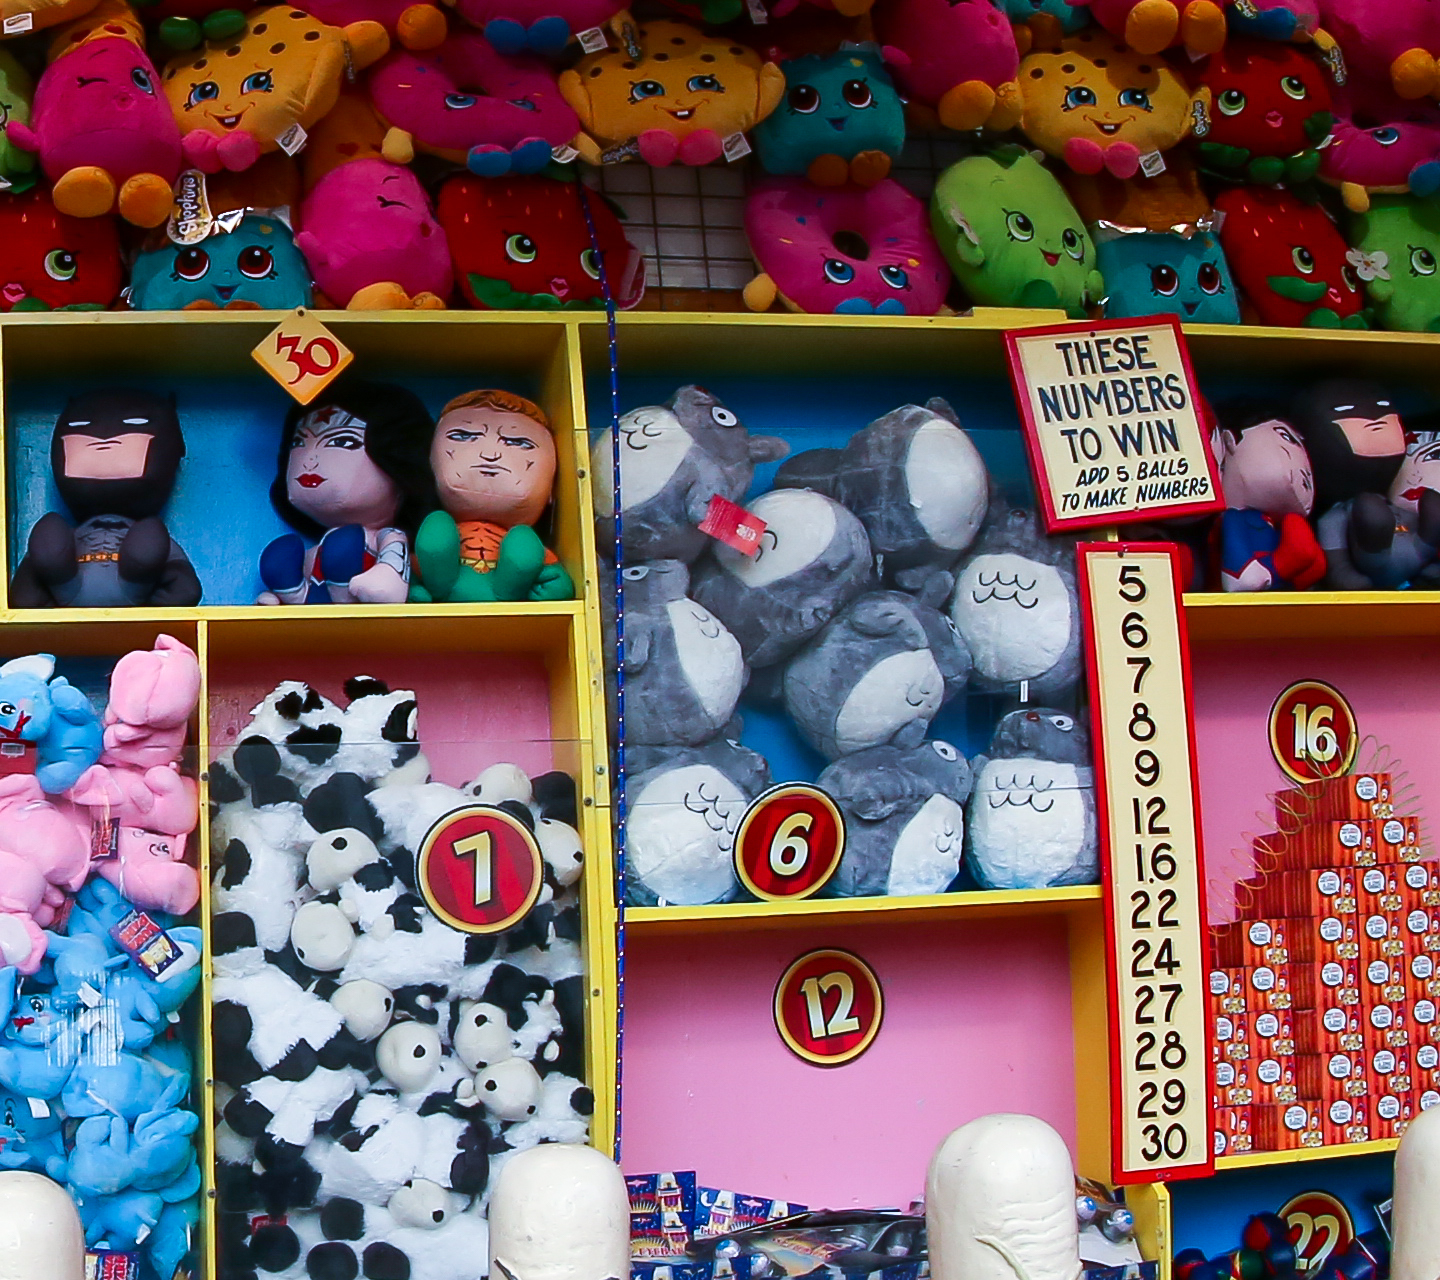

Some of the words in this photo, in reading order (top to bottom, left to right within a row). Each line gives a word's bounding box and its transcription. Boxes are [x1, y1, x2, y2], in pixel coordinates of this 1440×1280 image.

[174, 175, 198, 238] Shopkins
[275, 332, 339, 384] 30
[1055, 335, 1158, 376] THESE
[1037, 374, 1186, 423] NUMBERS
[1060, 426, 1103, 464] TO
[1108, 419, 1181, 458] WIN
[1076, 467, 1110, 487] ADD
[1117, 466, 1130, 483] 5
[1137, 459, 1189, 480] BALLS
[1062, 492, 1081, 510] TO
[1084, 487, 1128, 508] MAKE
[1137, 478, 1209, 502] NUMBERS
[1117, 564, 1145, 603] 5
[1121, 610, 1149, 649] 6
[1127, 657, 1152, 695] 7
[1128, 701, 1155, 742] 8
[1291, 703, 1337, 763] 16
[1133, 749, 1161, 787] 9
[1133, 797, 1168, 836] 12
[769, 811, 813, 877] 6
[1136, 842, 1177, 883] 16
[453, 829, 497, 907] 7
[1131, 890, 1179, 930] 22
[1132, 939, 1180, 977] 24
[801, 970, 860, 1040] 12
[1134, 985, 1182, 1023] 27
[1136, 1031, 1187, 1070] 28
[1138, 1078, 1186, 1117] 29
[1140, 1124, 1189, 1162] 30
